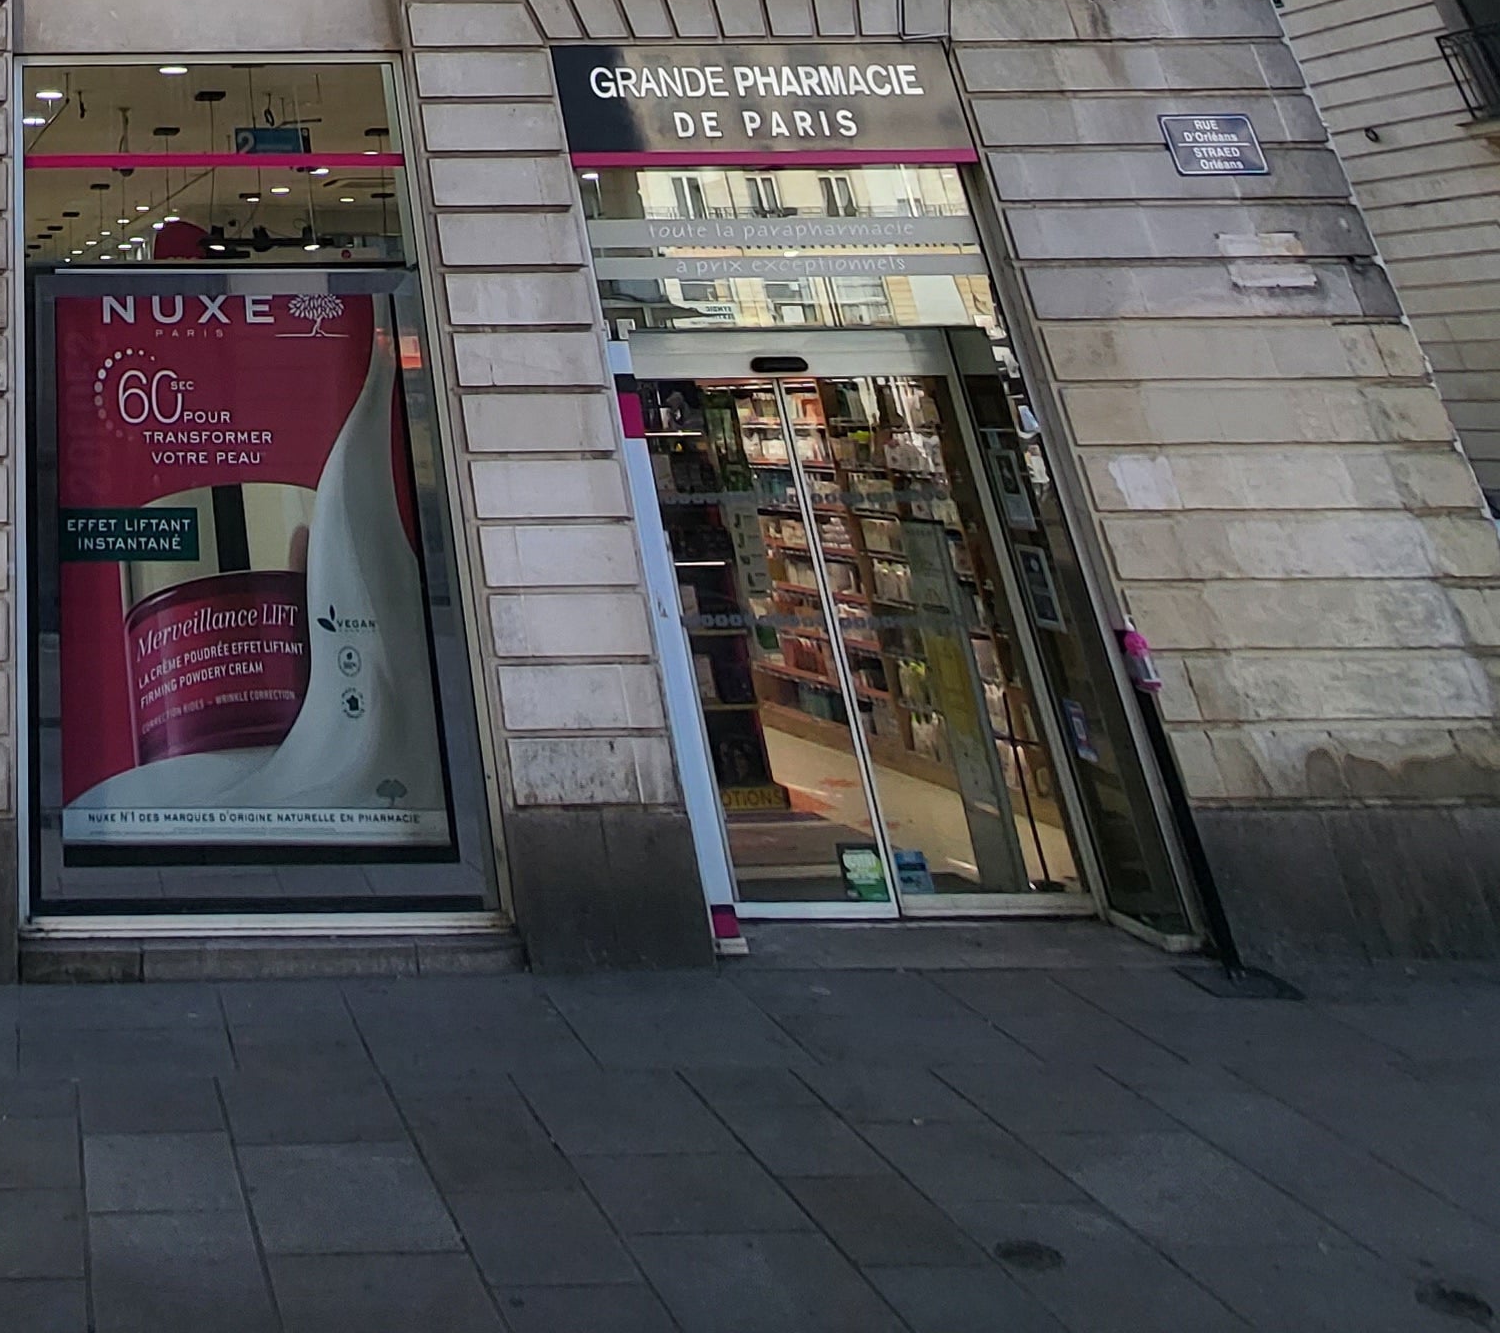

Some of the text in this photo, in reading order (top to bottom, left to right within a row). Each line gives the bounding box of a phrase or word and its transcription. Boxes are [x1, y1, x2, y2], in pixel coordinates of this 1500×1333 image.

[589, 64, 925, 99] GRANDE PHARMACIE
[673, 109, 858, 138] DE PARIS
[1193, 119, 1219, 131] RUE
[1193, 147, 1240, 158] STRAED
[650, 220, 915, 241] toute la parapharmacie
[696, 258, 742, 276] prix
[752, 256, 905, 275] exceptionnels
[102, 294, 275, 324] NUXE
[155, 329, 224, 338] PARIS
[118, 369, 195, 424] 60 SEC
[183, 411, 231, 424] POUR
[143, 431, 273, 444] TRANSFORMER
[152, 451, 260, 465] VOTRE PEAU
[67, 519, 191, 532] EFFET LIFTANT
[78, 534, 181, 550] INSTANTANÉ
[336, 619, 376, 629] VEGAN
[136, 603, 299, 663] Merveillance LIFT
[184, 640, 230, 665] POUDRÉE
[231, 641, 262, 655] EFFET
[263, 641, 303, 656] LIFTANT
[140, 661, 264, 710] FIRMING POWDERY CREAM
[88, 813, 116, 823] NUXE
[138, 812, 159, 823] DES
[164, 812, 215, 823] MARQUES
[219, 810, 273, 823] D'ORIGINE
[277, 813, 336, 823] NATURELLE
[340, 813, 354, 823] EN
[358, 813, 421, 824] PHARMACIE
